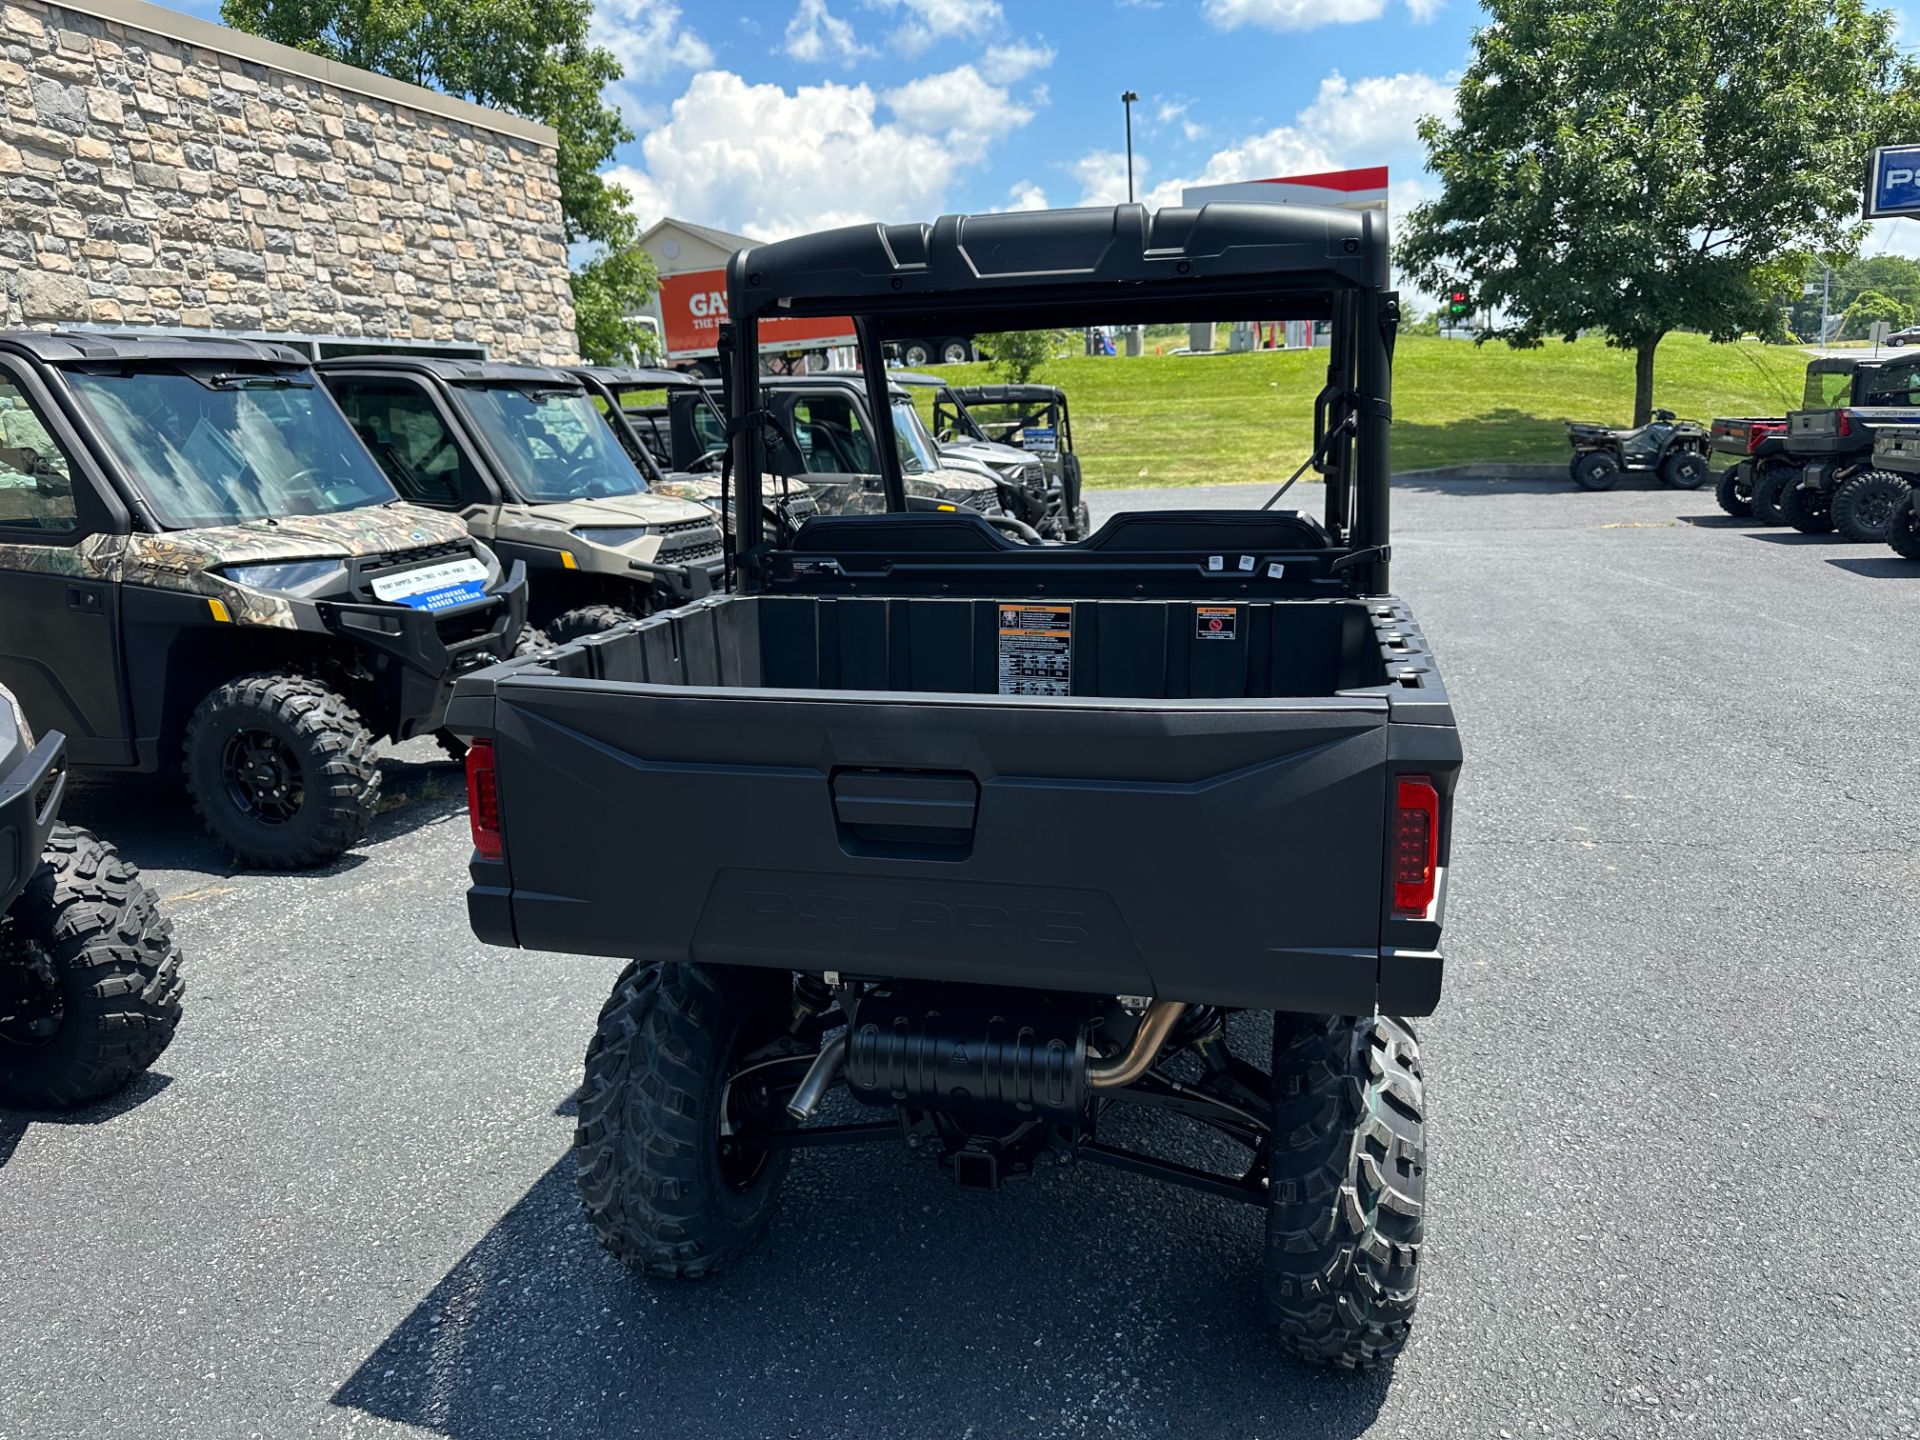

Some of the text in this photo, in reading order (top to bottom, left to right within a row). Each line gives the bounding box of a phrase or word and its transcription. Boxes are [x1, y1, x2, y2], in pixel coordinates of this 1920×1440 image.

[1886, 168, 1920, 189] P
[692, 318, 713, 329] THE
[508, 519, 562, 531] XP
[132, 545, 205, 564] XP
[139, 562, 189, 576] 1000
[426, 588, 466, 603] CONFIDENCE
[455, 592, 480, 603] TERRAIN
